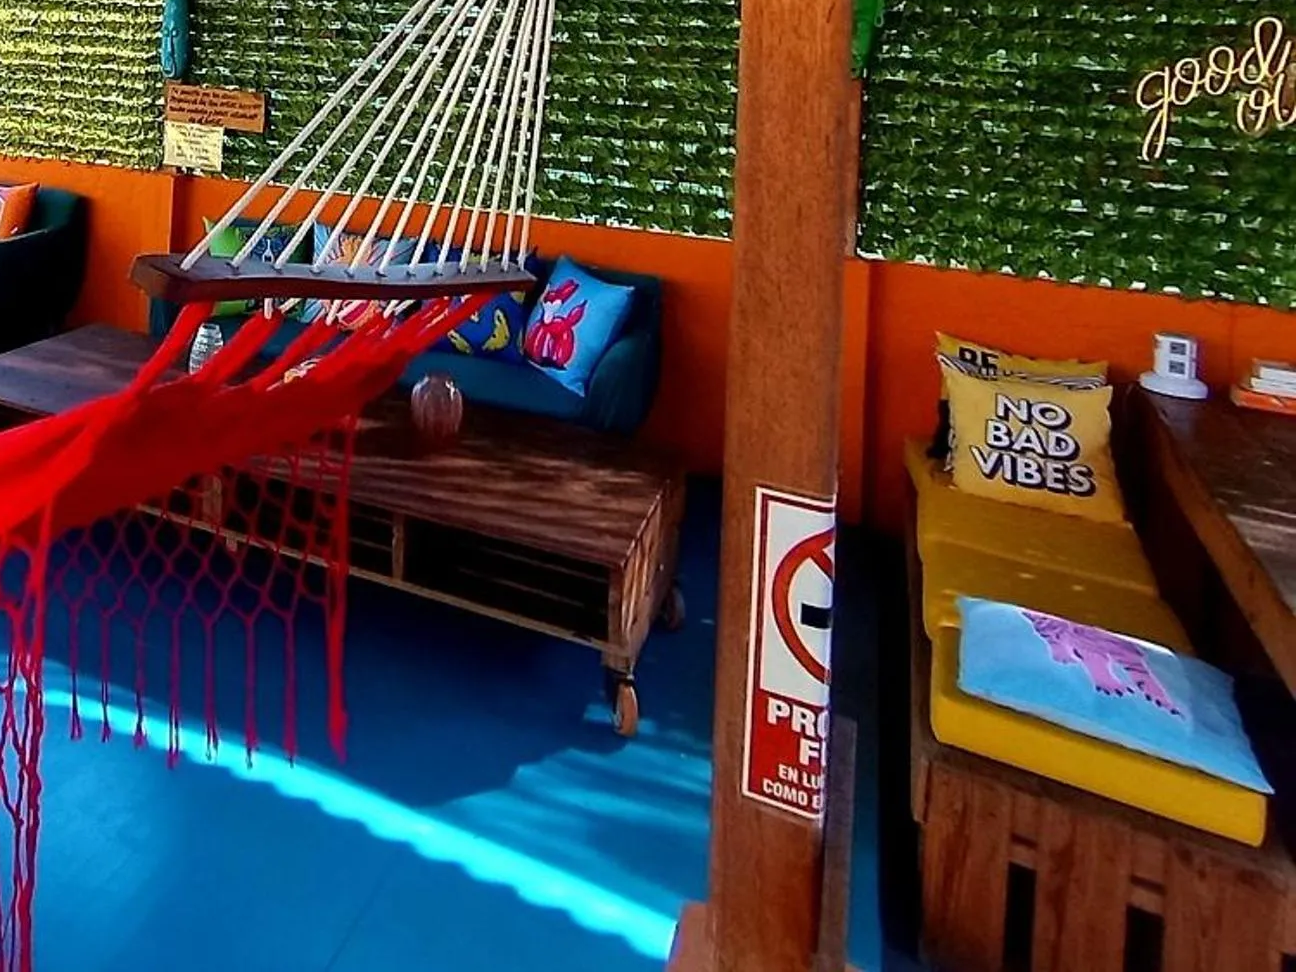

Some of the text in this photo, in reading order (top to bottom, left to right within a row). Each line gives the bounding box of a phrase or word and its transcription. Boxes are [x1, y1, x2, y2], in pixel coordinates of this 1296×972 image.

[1136, 16, 1292, 161] good
[994, 392, 1072, 429] NO
[985, 418, 1080, 463] BAD
[969, 444, 1097, 497] VIBES
[799, 737, 827, 767] F
[762, 778, 808, 806] COMO
[778, 763, 799, 784] EN
